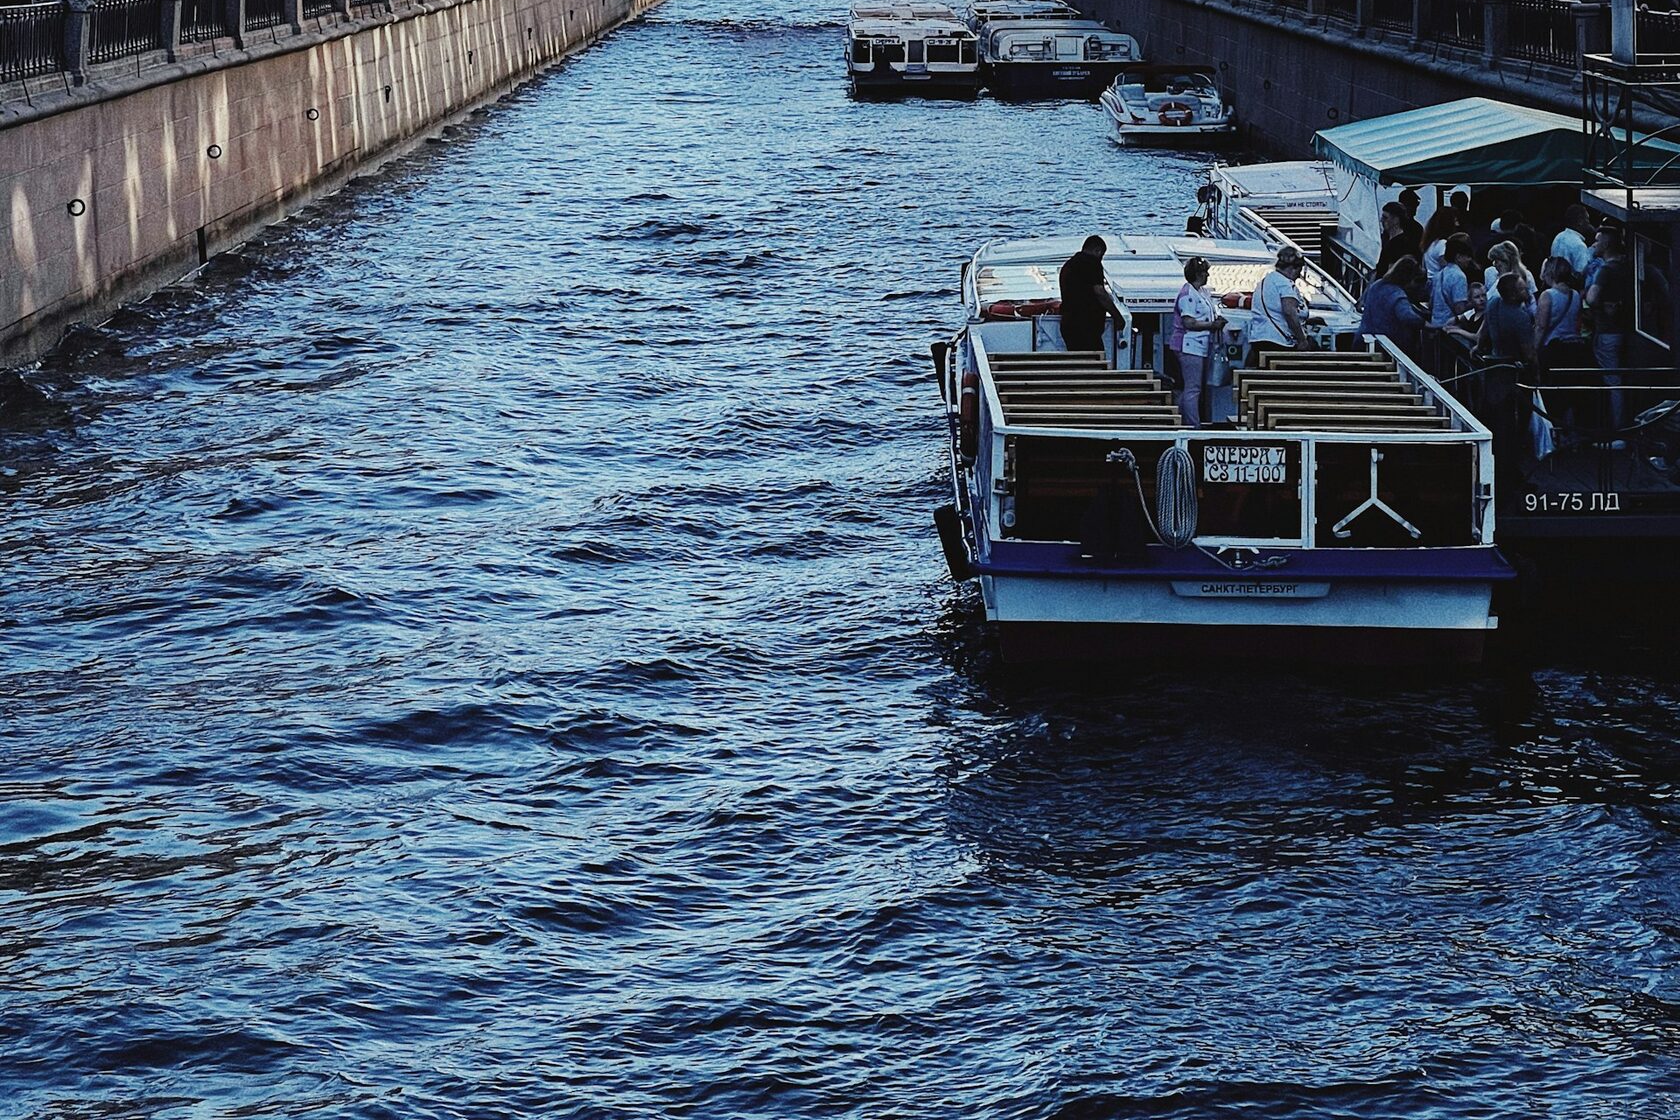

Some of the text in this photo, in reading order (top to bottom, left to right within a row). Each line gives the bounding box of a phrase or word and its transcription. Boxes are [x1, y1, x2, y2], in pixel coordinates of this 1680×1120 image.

[1205, 446, 1286, 465] СИЕРРА 7
[1234, 465, 1281, 482] 11-100
[1525, 492, 1620, 511] 91-75 ЛД
[1201, 584, 1299, 594] САНКТ-ПЕТЕРБУРГ
